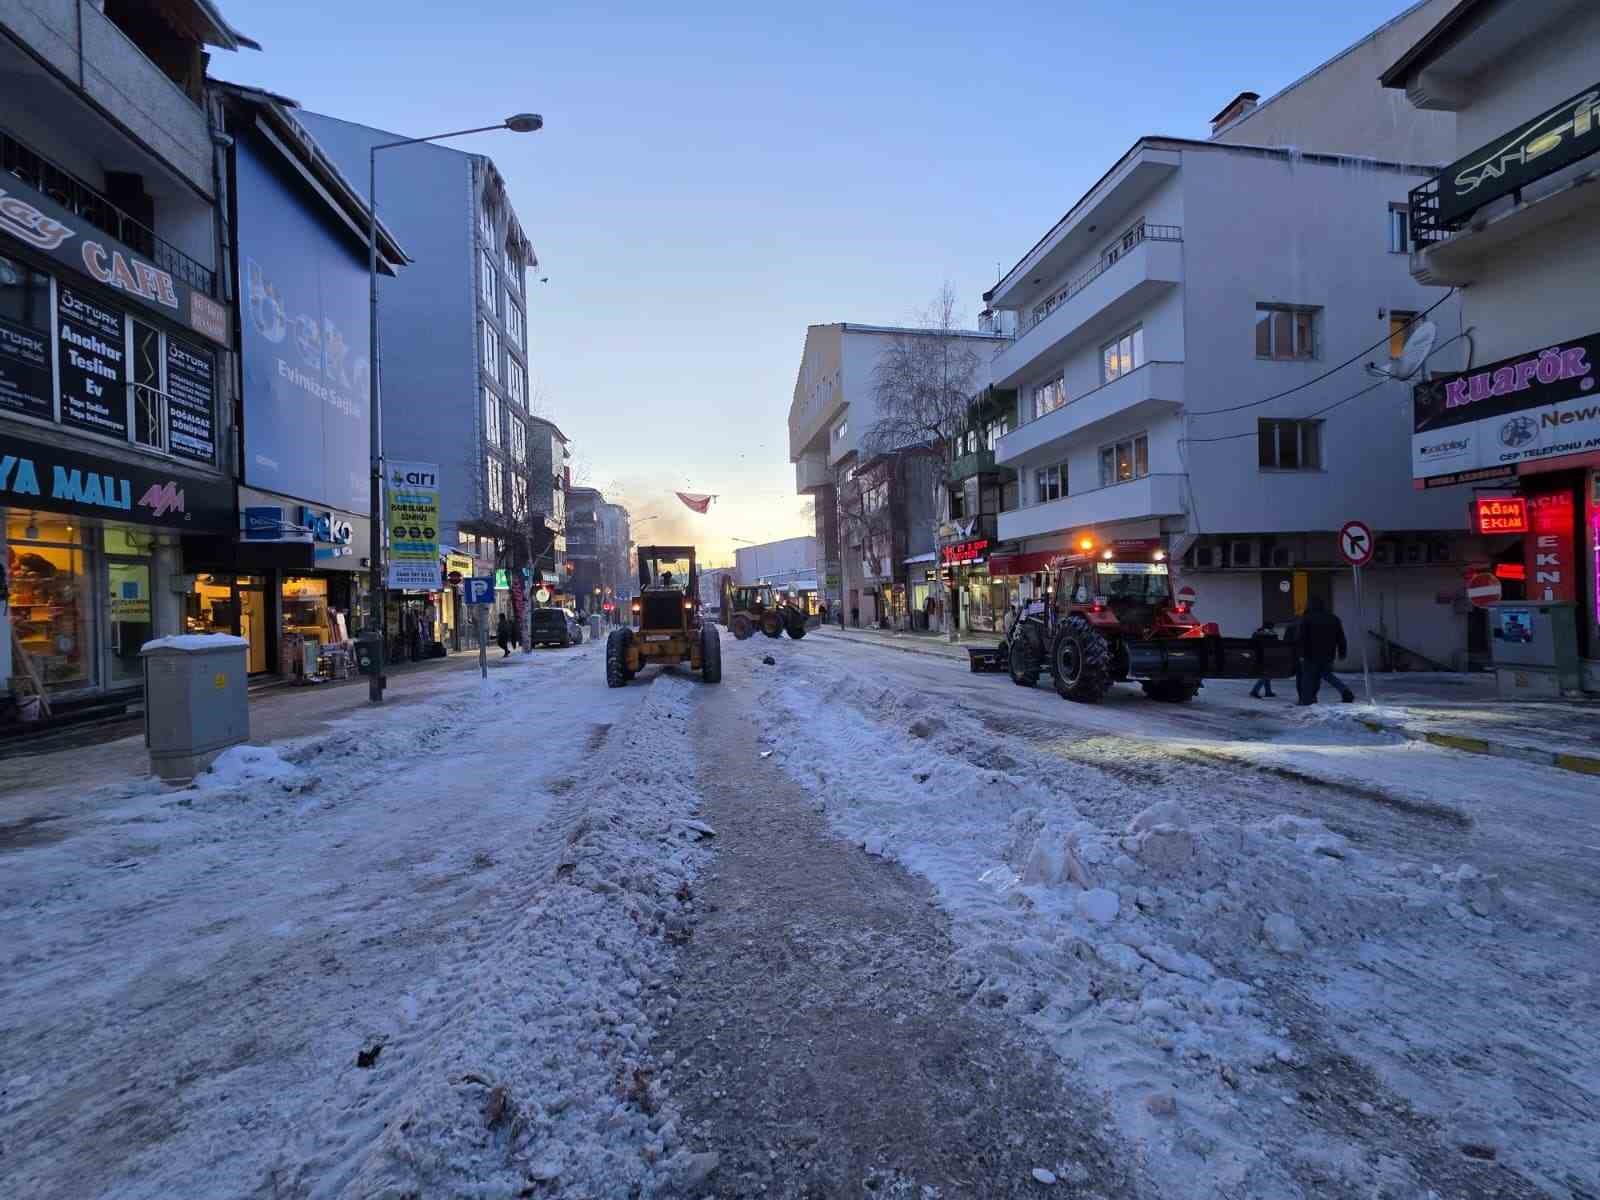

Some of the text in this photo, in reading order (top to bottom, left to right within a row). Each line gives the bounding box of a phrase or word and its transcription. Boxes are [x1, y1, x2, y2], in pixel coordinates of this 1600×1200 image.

[81, 240, 178, 309] CAFE
[61, 325, 122, 361] Anahtar
[69, 350, 117, 380] Teslim
[53, 465, 131, 511] MALI
